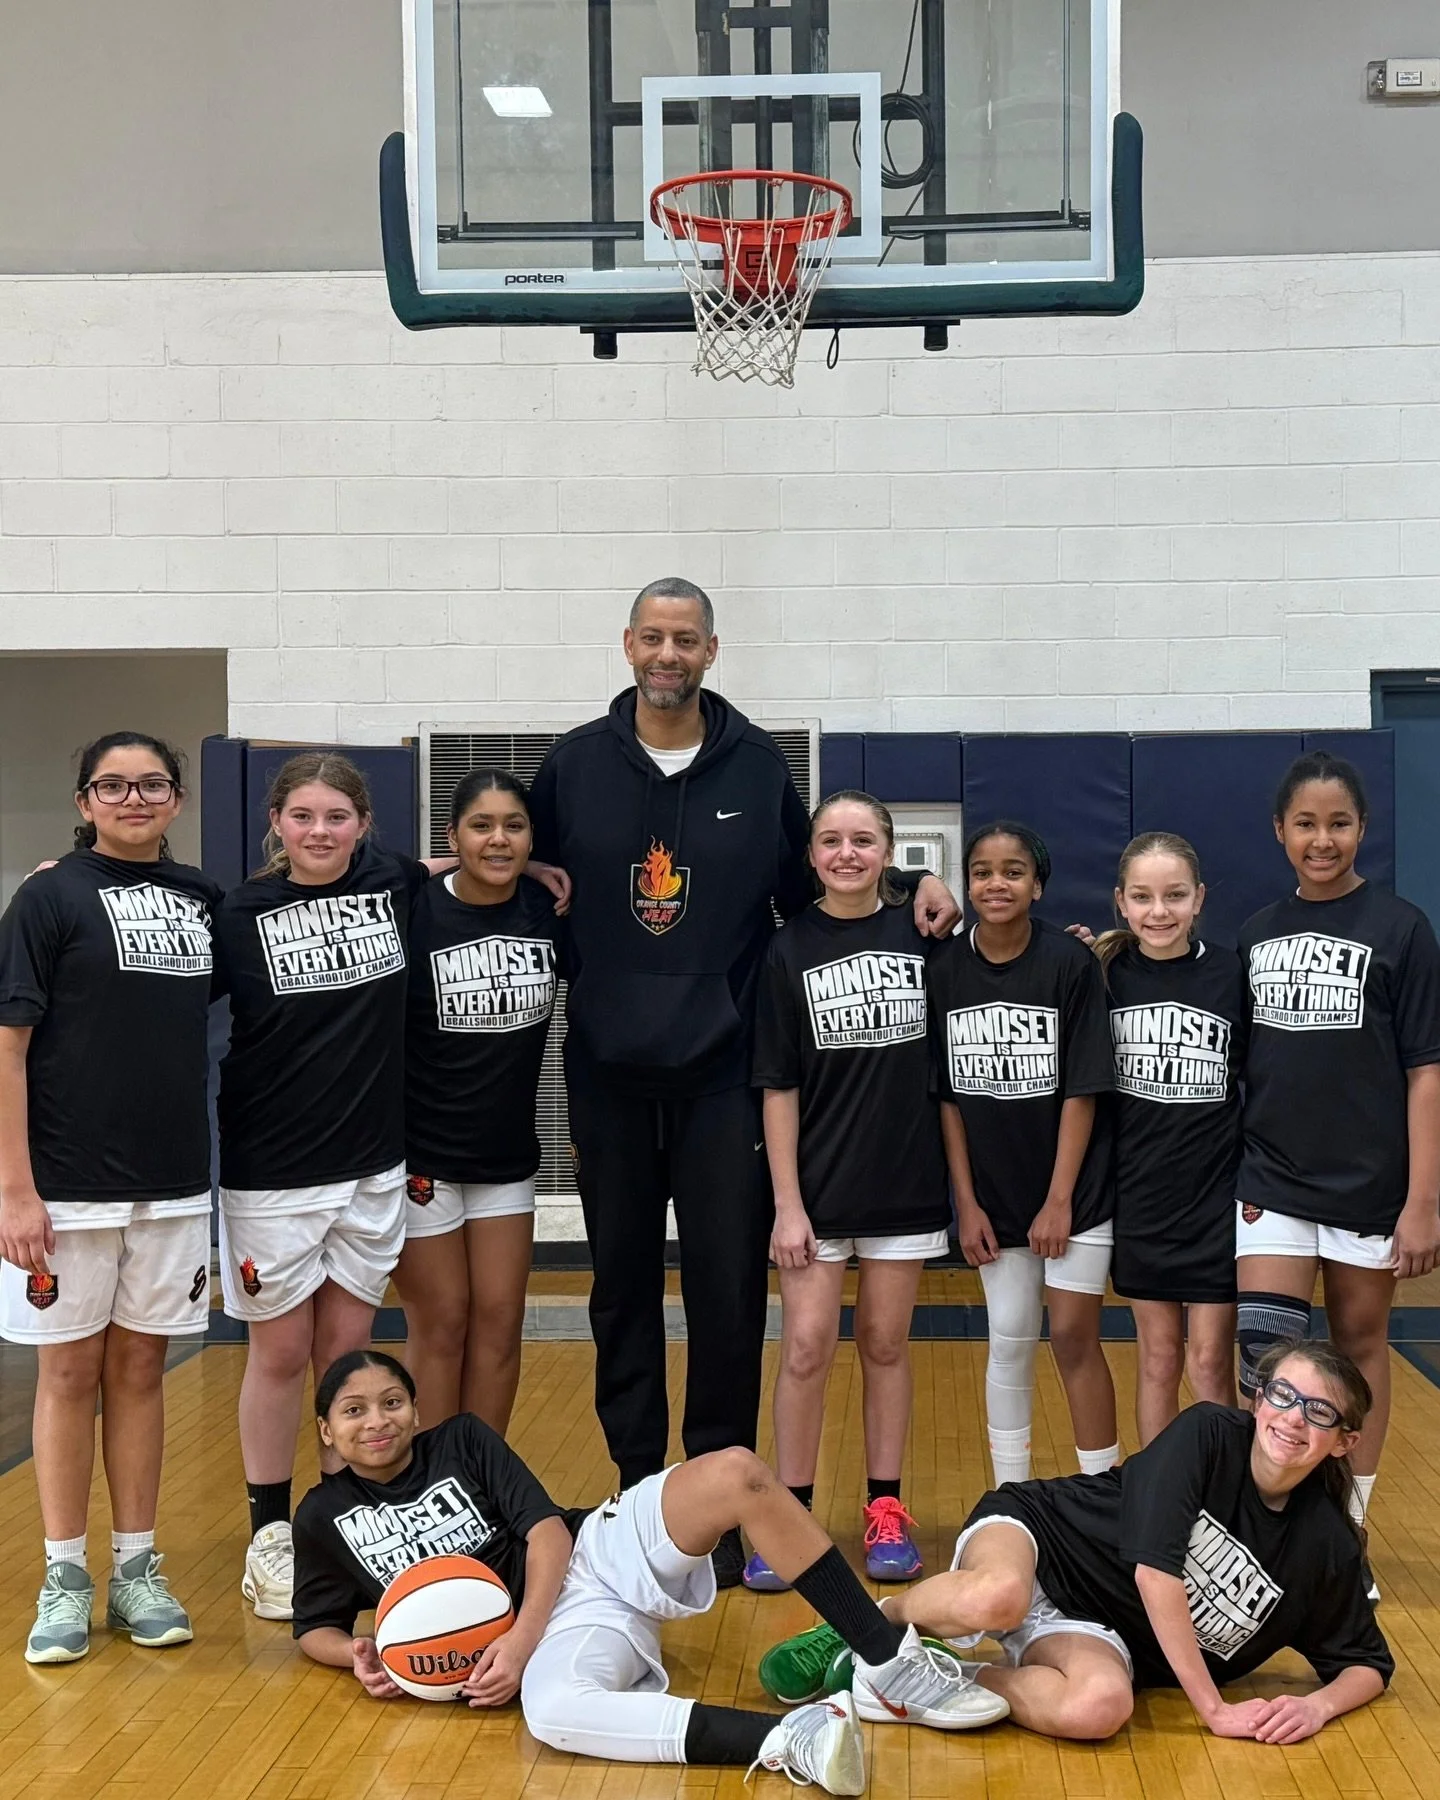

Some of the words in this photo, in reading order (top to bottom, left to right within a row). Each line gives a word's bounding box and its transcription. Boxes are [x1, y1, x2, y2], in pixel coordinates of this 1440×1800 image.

[505, 273, 564, 286] porter
[263, 893, 389, 947] MINDSET
[326, 930, 345, 945] IS
[128, 954, 201, 970] BBALLSHOOTOUT
[272, 931, 399, 978] EVERYTHING
[436, 939, 551, 984] MINDSET
[1251, 936, 1366, 978] MINDSET
[280, 967, 363, 988] BBALLSHOOTOUT
[366, 955, 401, 974] CHAMPS
[493, 976, 509, 988] IS
[808, 955, 924, 1002] MINDSET
[1291, 971, 1307, 984] IS
[442, 982, 554, 1015] EVERYTHING
[866, 989, 883, 1003] IS
[1254, 983, 1359, 1011] VERYTHING
[446, 1013, 519, 1027] BBALLSHOOTOUT
[522, 1004, 551, 1021] CHAMPS
[815, 1000, 925, 1033] EVERYTHING
[950, 1006, 1055, 1045] MINDSET
[1113, 1006, 1227, 1053] MINDSET
[1314, 1013, 1354, 1023] CHAMPS
[822, 1028, 893, 1043] BBALLSHOOTOUT
[896, 1022, 923, 1037] CHAMPS
[996, 1044, 1011, 1055] IS
[1161, 1044, 1178, 1057] IS
[1115, 1053, 1225, 1085] EVERYTHING
[1026, 1079, 1056, 1091] CHAMP
[1188, 1086, 1221, 1096] CHAMPS
[340, 1485, 464, 1550] MINDSET
[1187, 1517, 1279, 1620] MINDSET
[407, 1644, 490, 1676] Wilso
